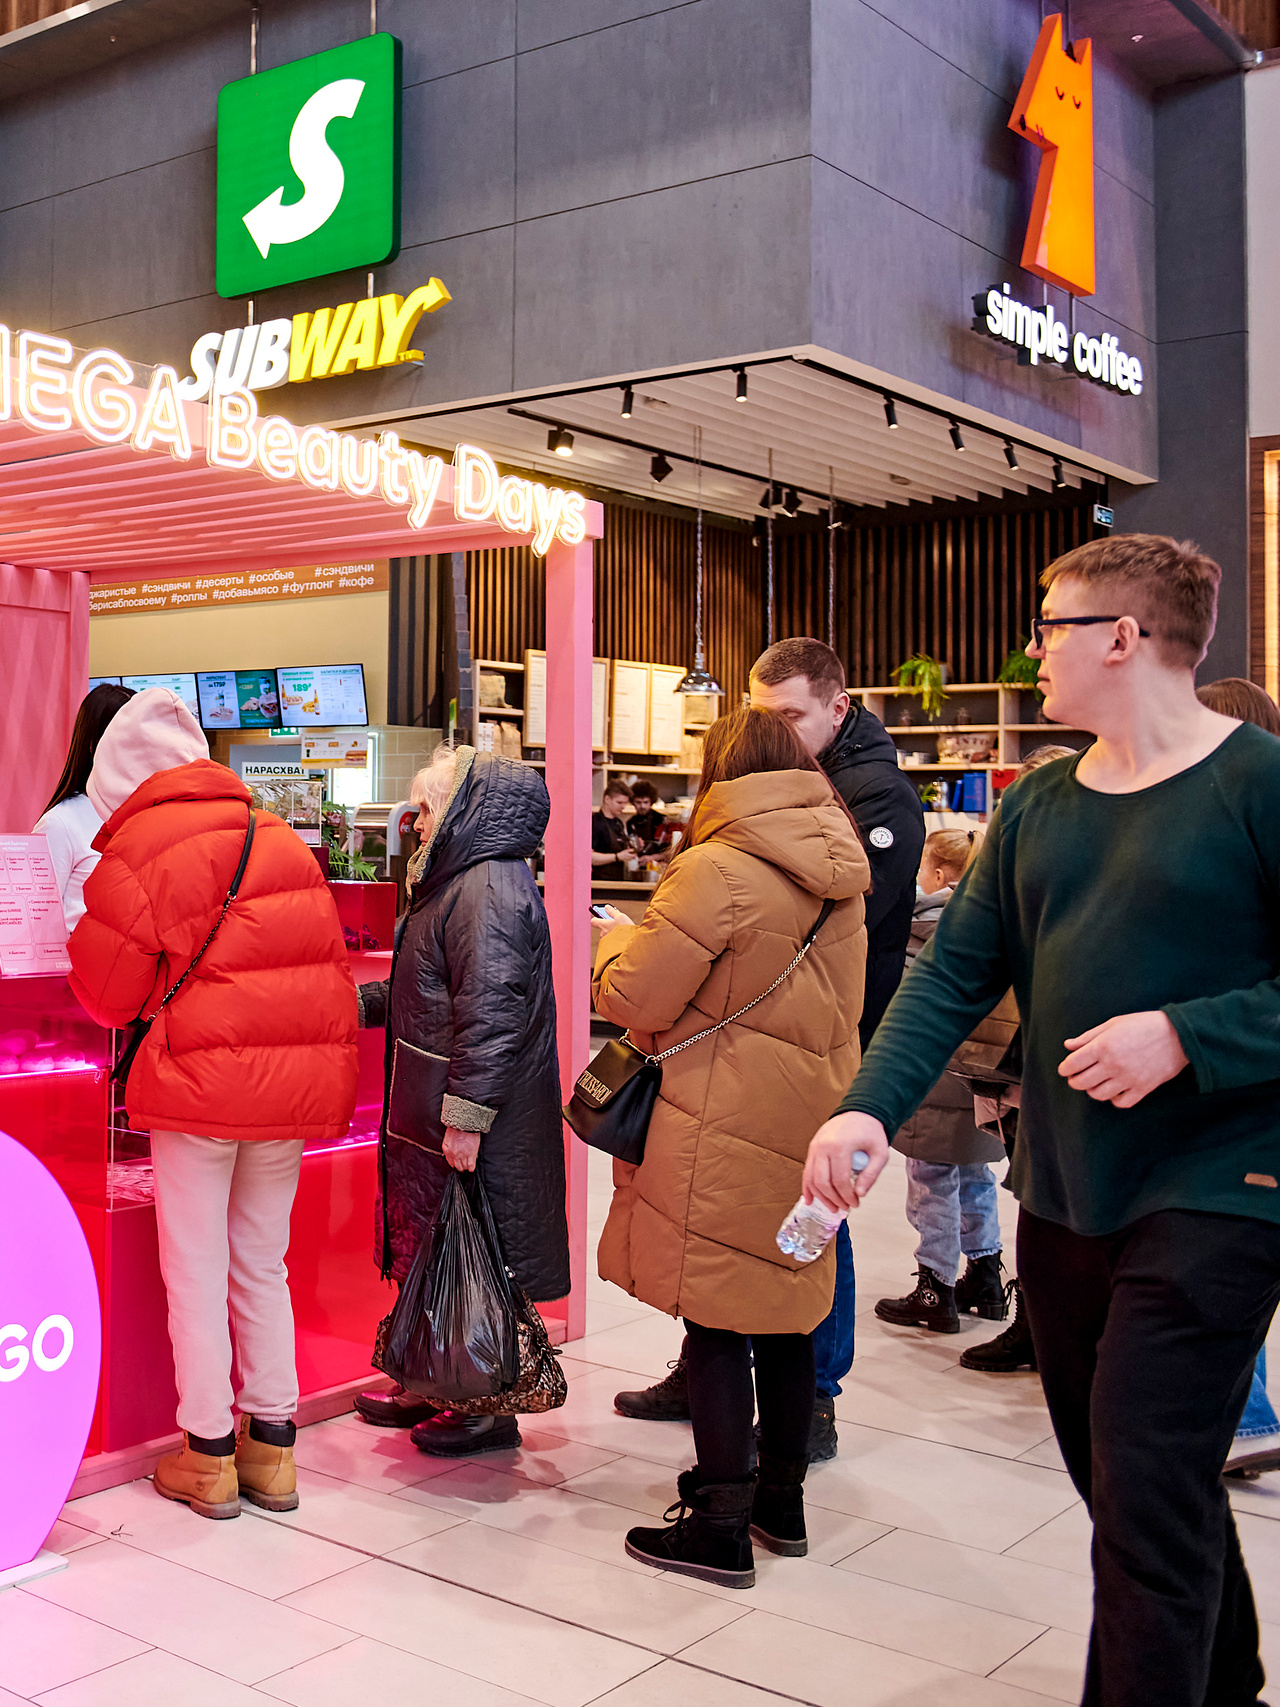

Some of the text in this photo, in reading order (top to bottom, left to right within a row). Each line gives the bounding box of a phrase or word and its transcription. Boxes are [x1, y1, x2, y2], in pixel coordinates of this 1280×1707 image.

[180, 277, 452, 402] SUBWAY
[986, 282, 1144, 396] simple coffee
[207, 386, 442, 531] Beauty
[452, 441, 586, 558] Days
[141, 581, 191, 594] #сэндвичи
[195, 576, 244, 590] #десерты
[248, 570, 295, 584] #особые
[314, 563, 375, 577] #сэндвичи
[171, 592, 208, 605] #роллы
[212, 585, 279, 600] #добавьмясо
[282, 580, 335, 595] #футлонг
[338, 575, 375, 588] #кофе
[576, 1070, 613, 1104] TRUSSARDI
